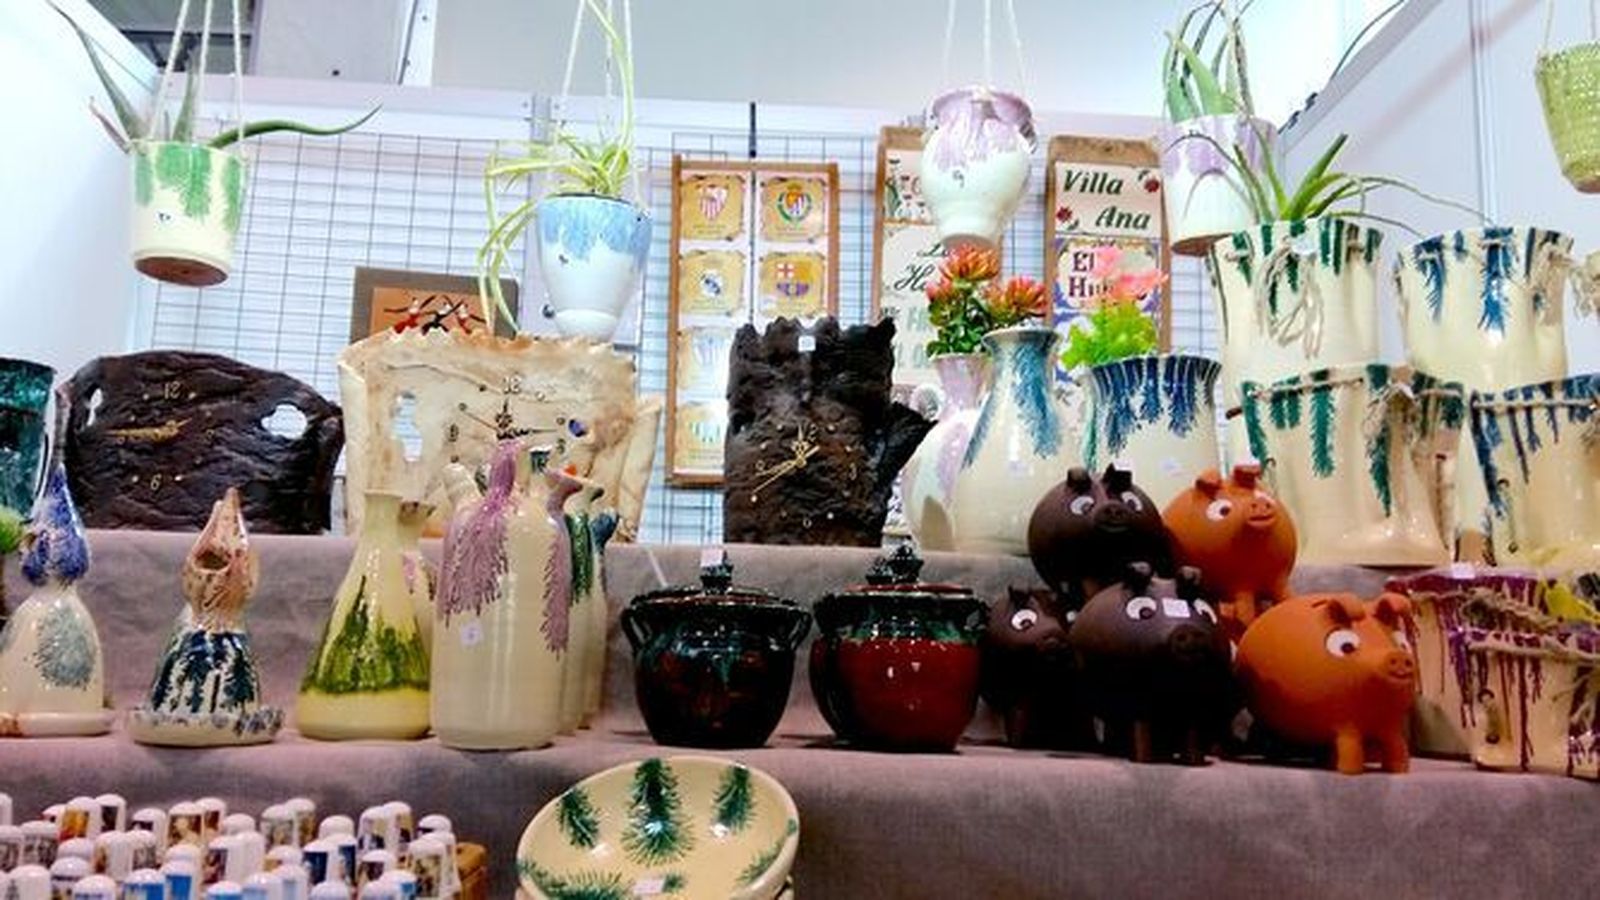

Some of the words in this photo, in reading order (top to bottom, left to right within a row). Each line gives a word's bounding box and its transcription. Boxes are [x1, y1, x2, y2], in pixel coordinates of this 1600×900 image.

[1063, 169, 1124, 195] Villa
[1094, 205, 1151, 230] Ana
[1072, 251, 1095, 272] El
[164, 380, 181, 400] 12
[150, 473, 162, 491] 6
